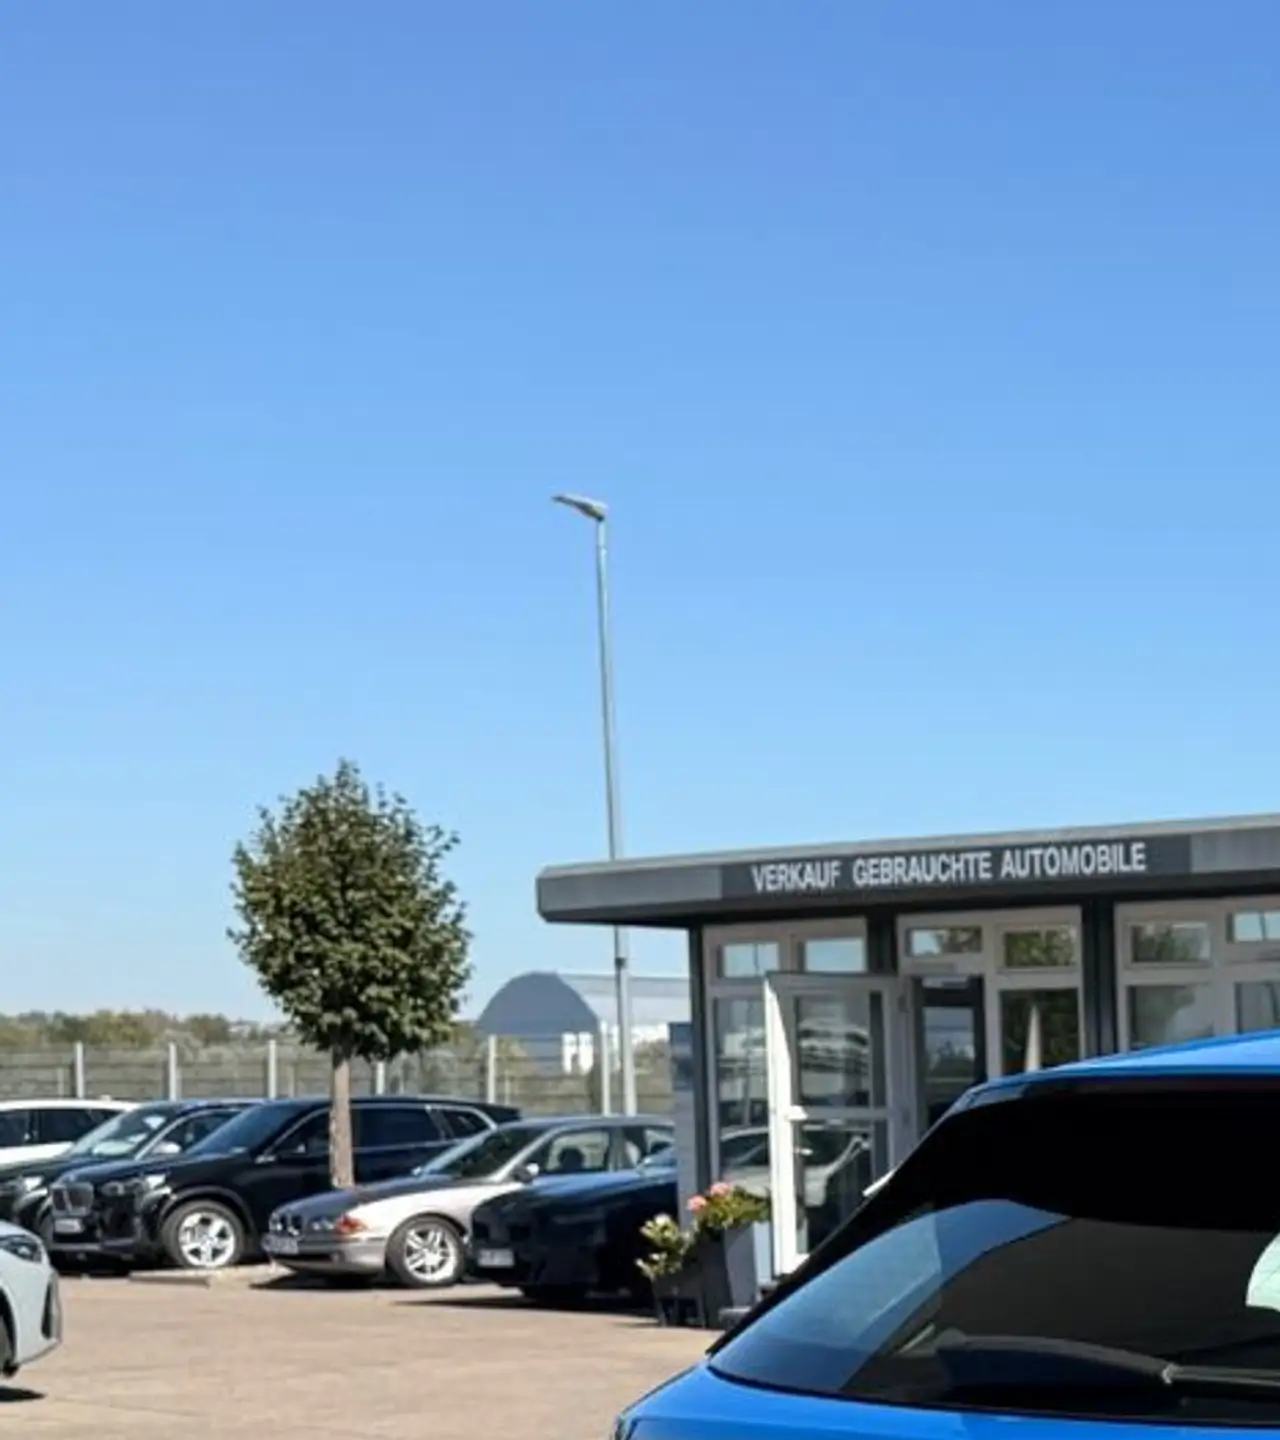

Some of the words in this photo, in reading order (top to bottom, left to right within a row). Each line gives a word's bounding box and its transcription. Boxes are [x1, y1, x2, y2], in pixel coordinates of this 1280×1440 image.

[751, 860, 841, 893] VERKAUF
[852, 850, 993, 887] GEBRAUCHTE
[1001, 842, 1146, 879] AUTOMOBILE
